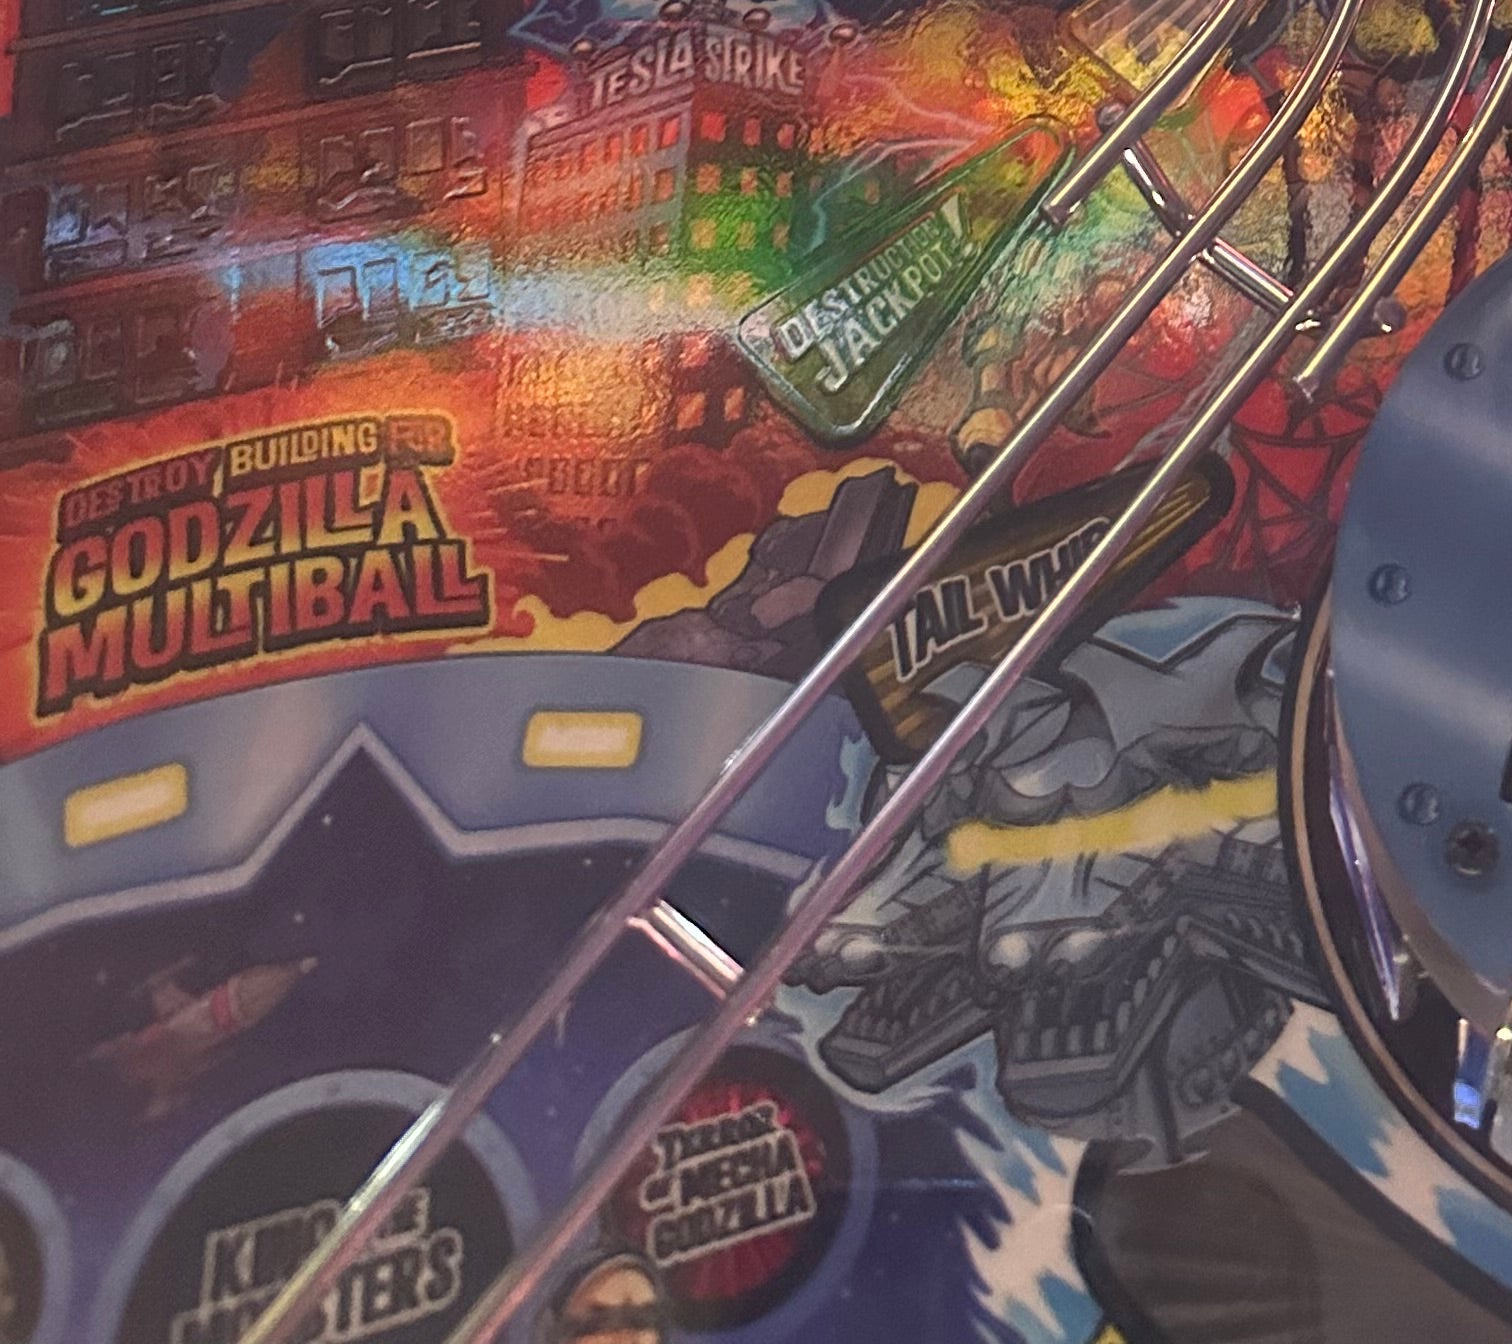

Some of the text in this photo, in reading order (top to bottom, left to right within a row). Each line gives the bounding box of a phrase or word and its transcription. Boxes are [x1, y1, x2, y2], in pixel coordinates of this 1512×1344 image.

[588, 25, 806, 108] TESLA STRIKE
[777, 215, 943, 361] DESTRUCTION
[60, 418, 453, 528] DESTROY BUILDING FOR
[52, 467, 444, 619] GODZILLA
[43, 542, 486, 700] MULTIBALL
[889, 574, 988, 683] TAIL
[647, 1168, 817, 1268] GODZILLA
